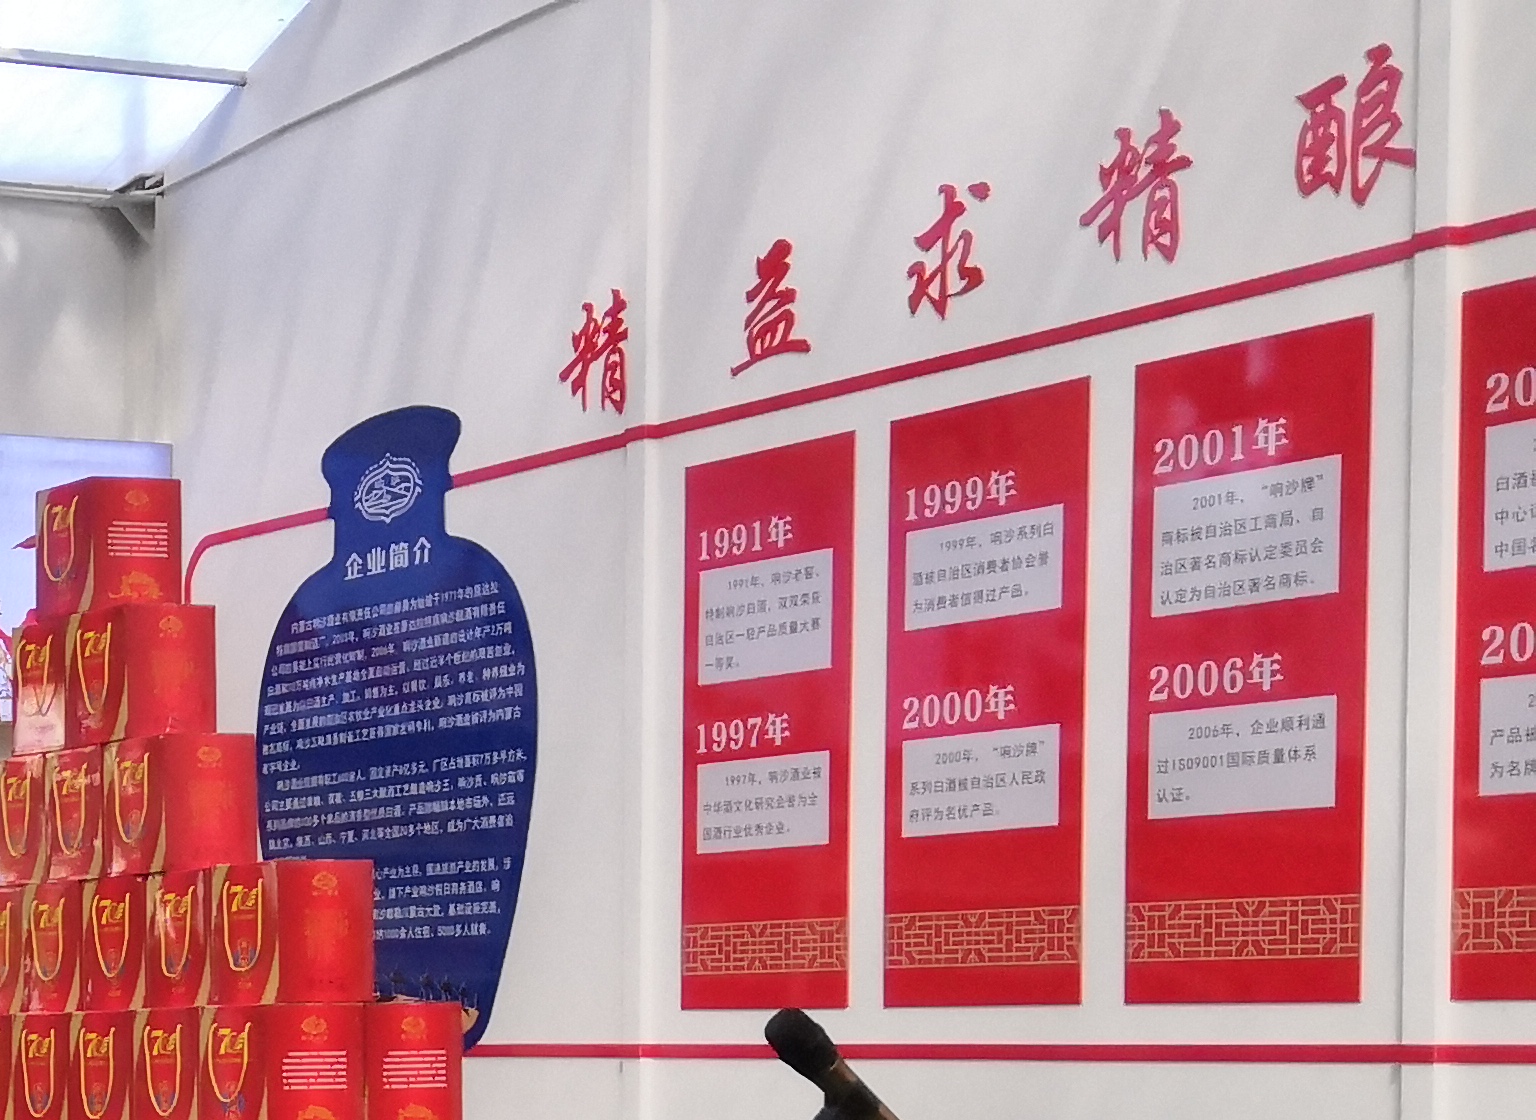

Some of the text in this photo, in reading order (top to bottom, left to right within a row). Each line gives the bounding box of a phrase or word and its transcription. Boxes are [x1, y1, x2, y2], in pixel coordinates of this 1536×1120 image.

[1152, 417, 1289, 475] 2001年
[905, 470, 1017, 521] 1999年
[344, 537, 432, 581] 企业简介
[698, 515, 793, 561] 1991年
[1149, 652, 1284, 702] 2006年
[902, 684, 1016, 729] 2000年
[696, 712, 790, 754] 1997年
